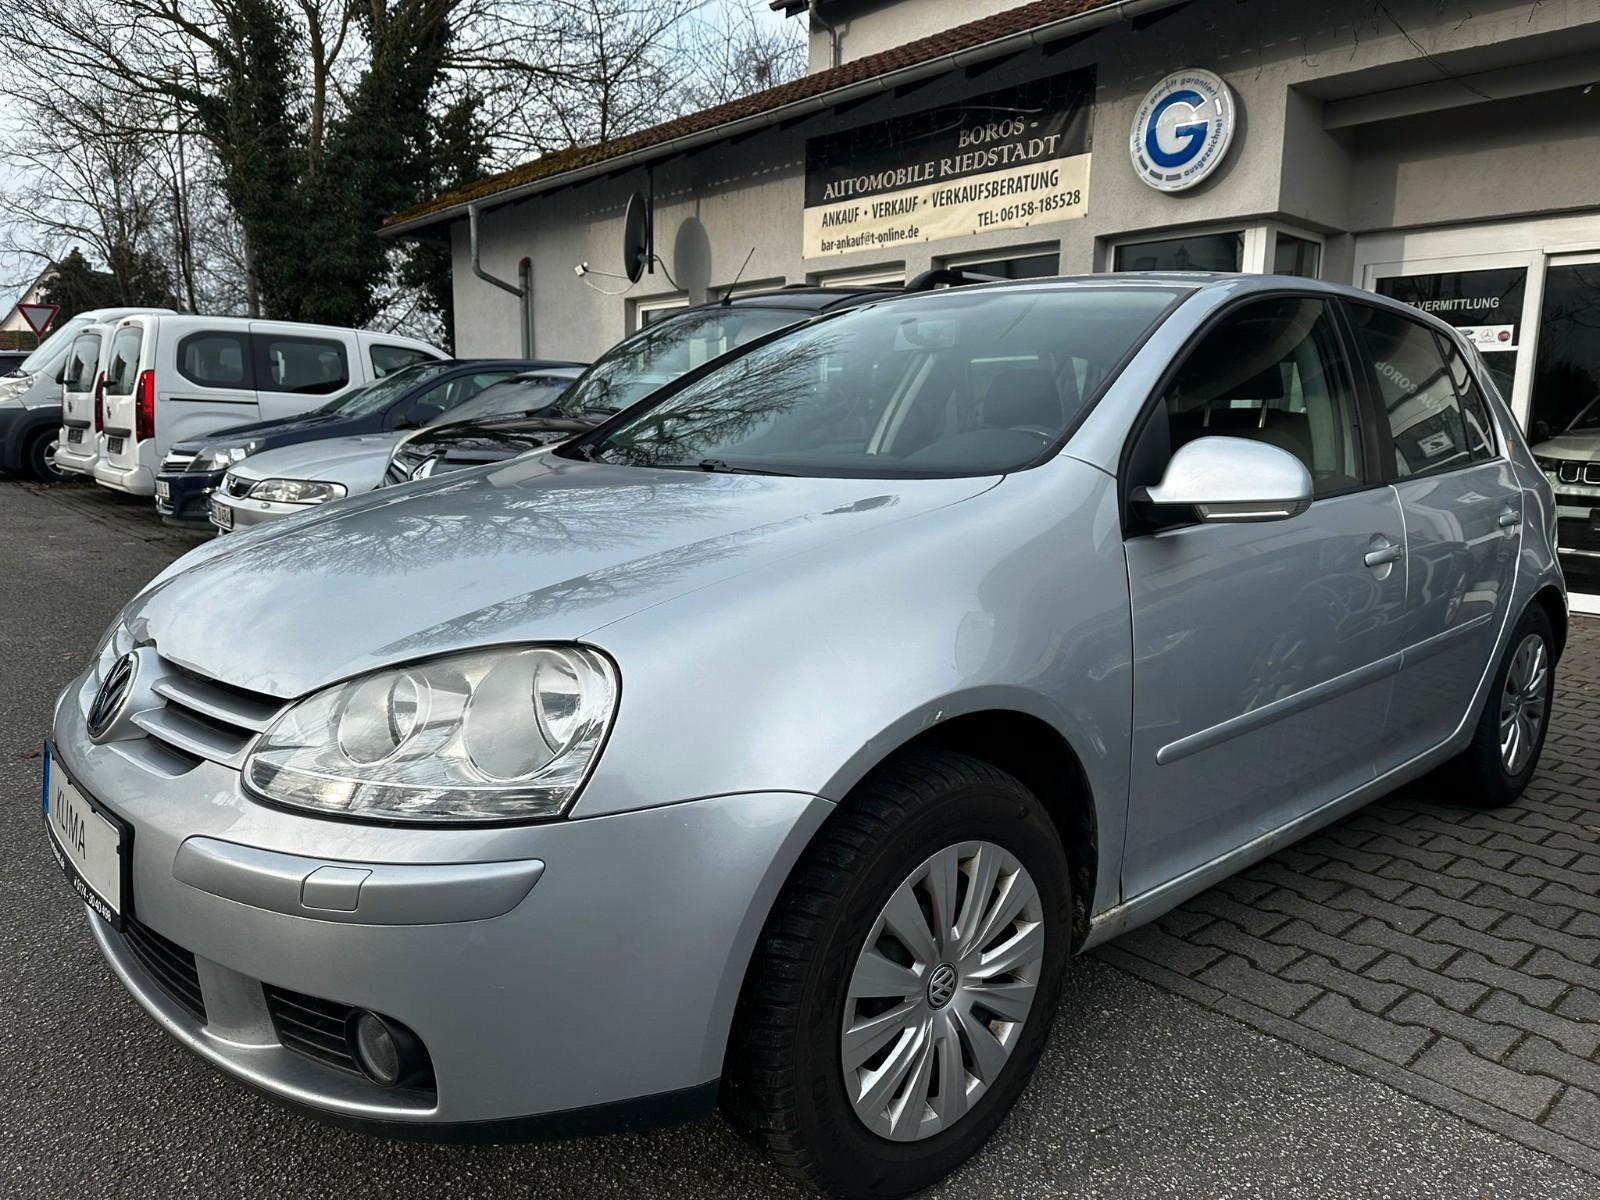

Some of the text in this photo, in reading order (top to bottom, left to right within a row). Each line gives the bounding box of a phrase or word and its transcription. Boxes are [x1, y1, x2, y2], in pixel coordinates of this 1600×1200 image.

[958, 116, 1025, 148] BOROS
[1145, 90, 1210, 168] G
[1184, 119, 1223, 176] ausgezeichnet
[823, 134, 1061, 200] AUTOMOBILE RIEDSTADT
[821, 168, 1060, 228] ANKAUF VERKAUF VERKAUFSBERATUNG
[1000, 189, 1081, 223] 06158-185528
[821, 225, 919, 252] bar-ankauf@t-online.de
[1417, 297, 1500, 312] VERMITTLUNG
[56, 786, 86, 861] KLIMA
